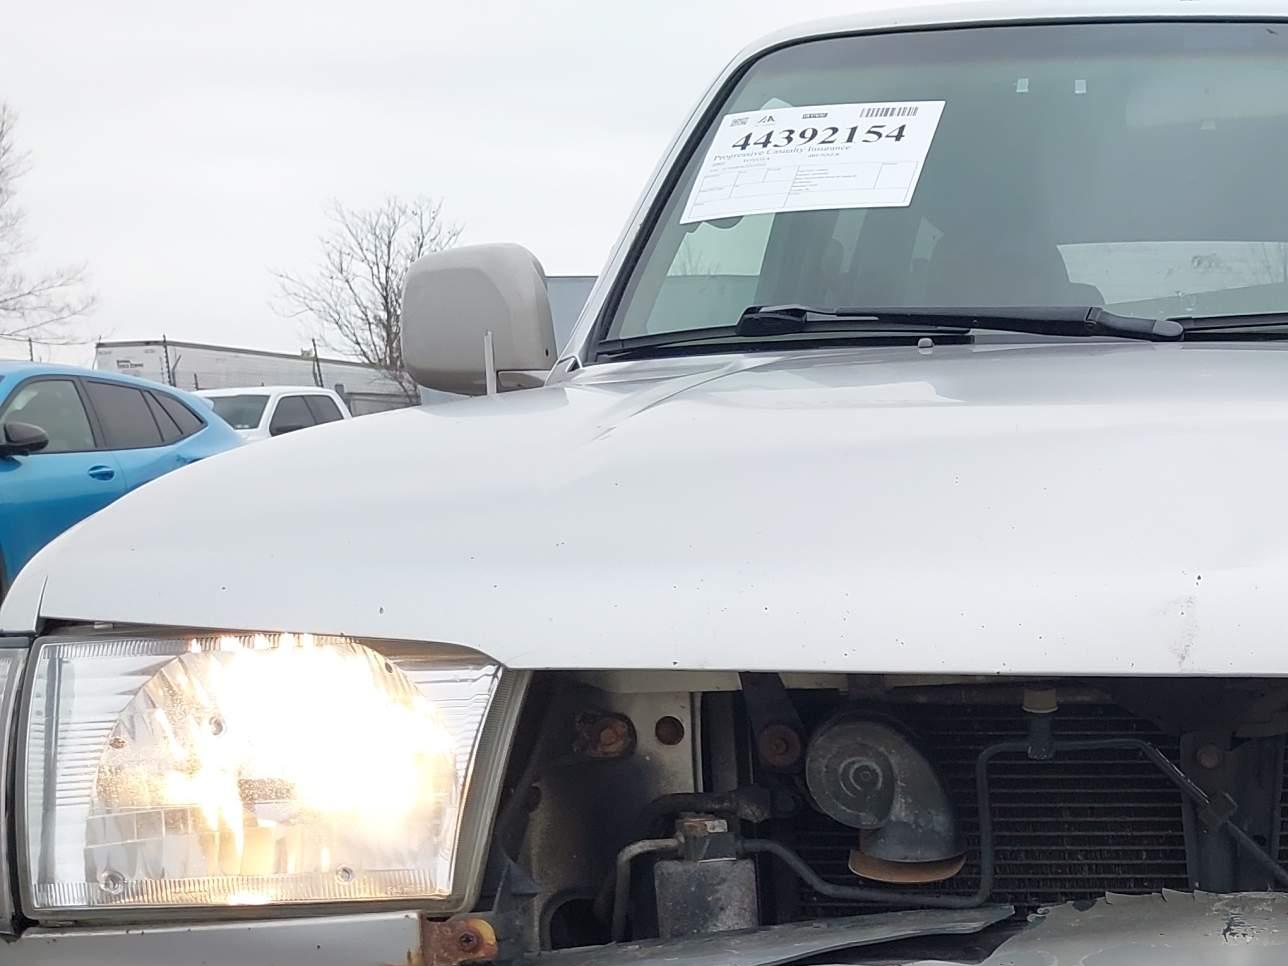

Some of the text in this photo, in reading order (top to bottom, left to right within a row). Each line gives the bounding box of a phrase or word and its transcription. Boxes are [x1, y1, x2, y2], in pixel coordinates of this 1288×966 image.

[731, 124, 907, 151] 44392154
[713, 150, 767, 162] Progressive
[766, 146, 804, 157] Casualty
[807, 144, 852, 153] Insurance
